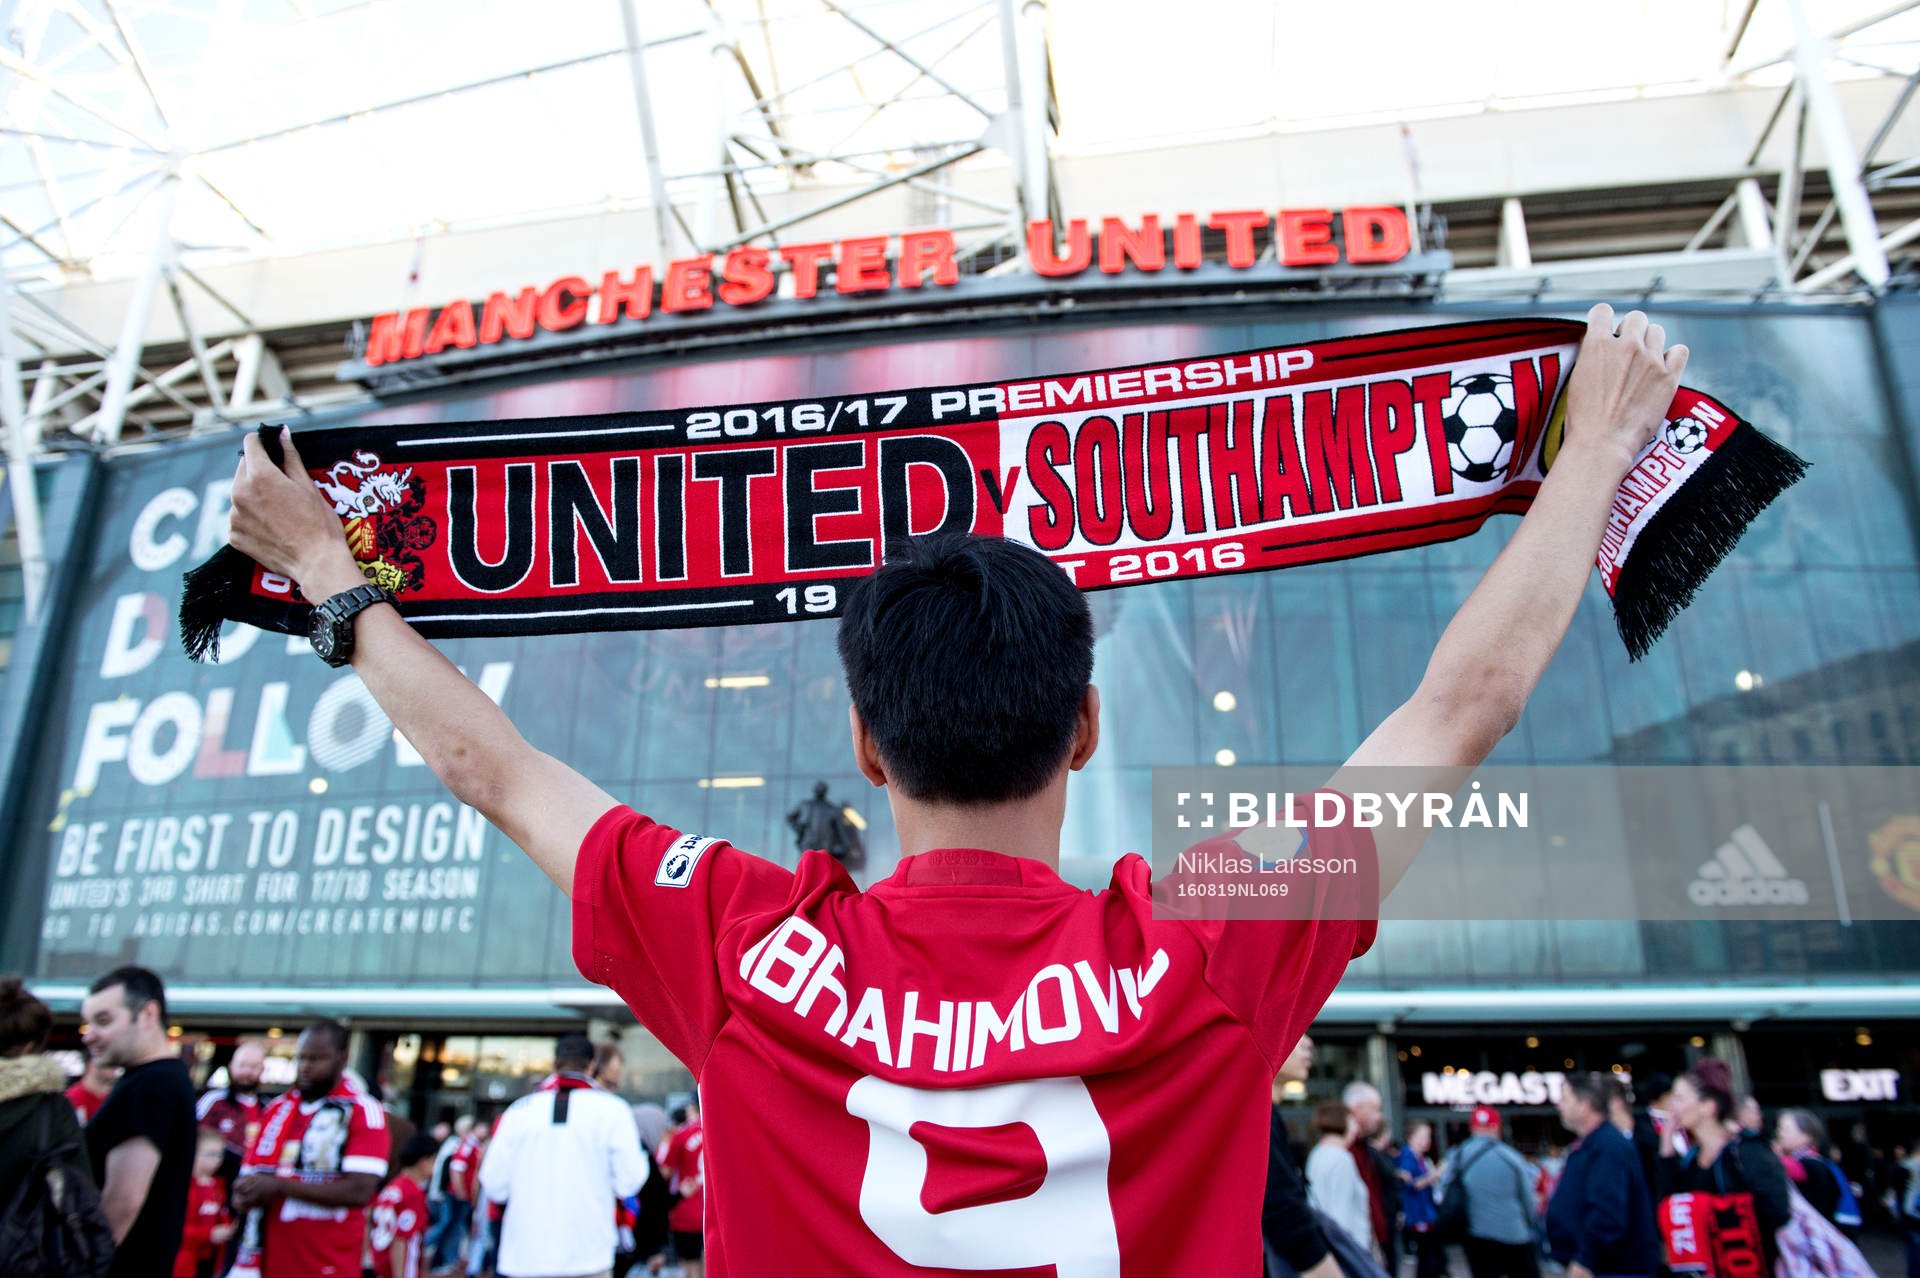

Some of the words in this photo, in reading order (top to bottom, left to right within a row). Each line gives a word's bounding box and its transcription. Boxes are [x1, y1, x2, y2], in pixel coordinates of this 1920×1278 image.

[366, 229, 960, 366] MANCHESTER
[1026, 204, 1412, 277] UNITED
[686, 397, 908, 440] 2016/17
[932, 349, 1314, 420] PREMIERSHIP
[446, 433, 978, 595] UNITED
[1109, 542, 1246, 582] 2016
[58, 822, 107, 877] BE
[114, 812, 232, 874] FIRST
[248, 810, 299, 868] TO
[313, 803, 487, 866] DESIGN
[183, 873, 246, 906] SHIRT
[255, 871, 299, 903] FOR
[382, 866, 480, 899] SEASON
[1820, 1068, 1900, 1101] EXIT
[846, 1075, 1122, 1278] 9
